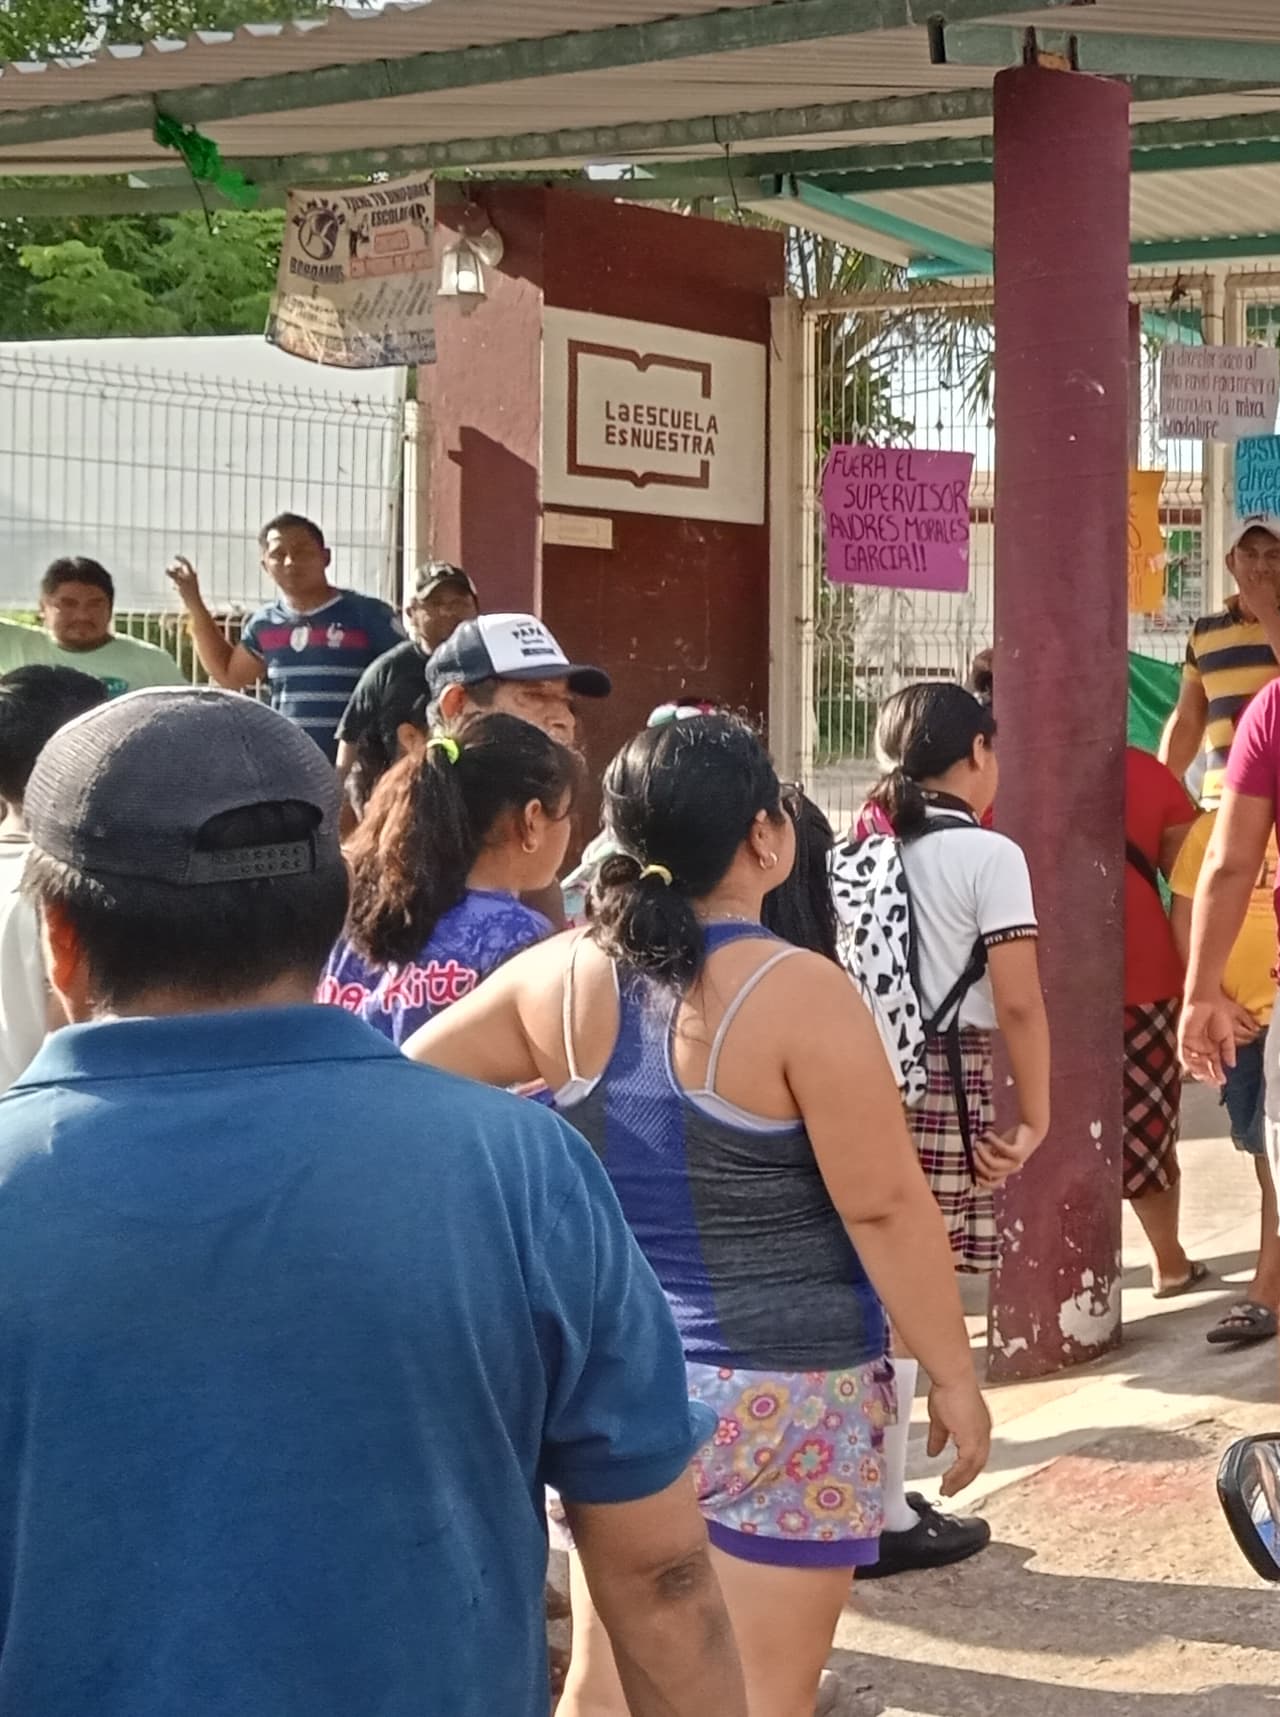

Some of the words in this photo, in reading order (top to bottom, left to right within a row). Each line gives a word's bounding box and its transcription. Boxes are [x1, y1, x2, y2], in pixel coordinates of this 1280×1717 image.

[832, 451, 887, 479] FUERA
[896, 453, 917, 481] EL
[844, 480, 969, 514] SUPERVISOR
[830, 513, 900, 542] ANDRES
[905, 517, 970, 544] MORALES
[844, 542, 927, 572] GARCIA!!
